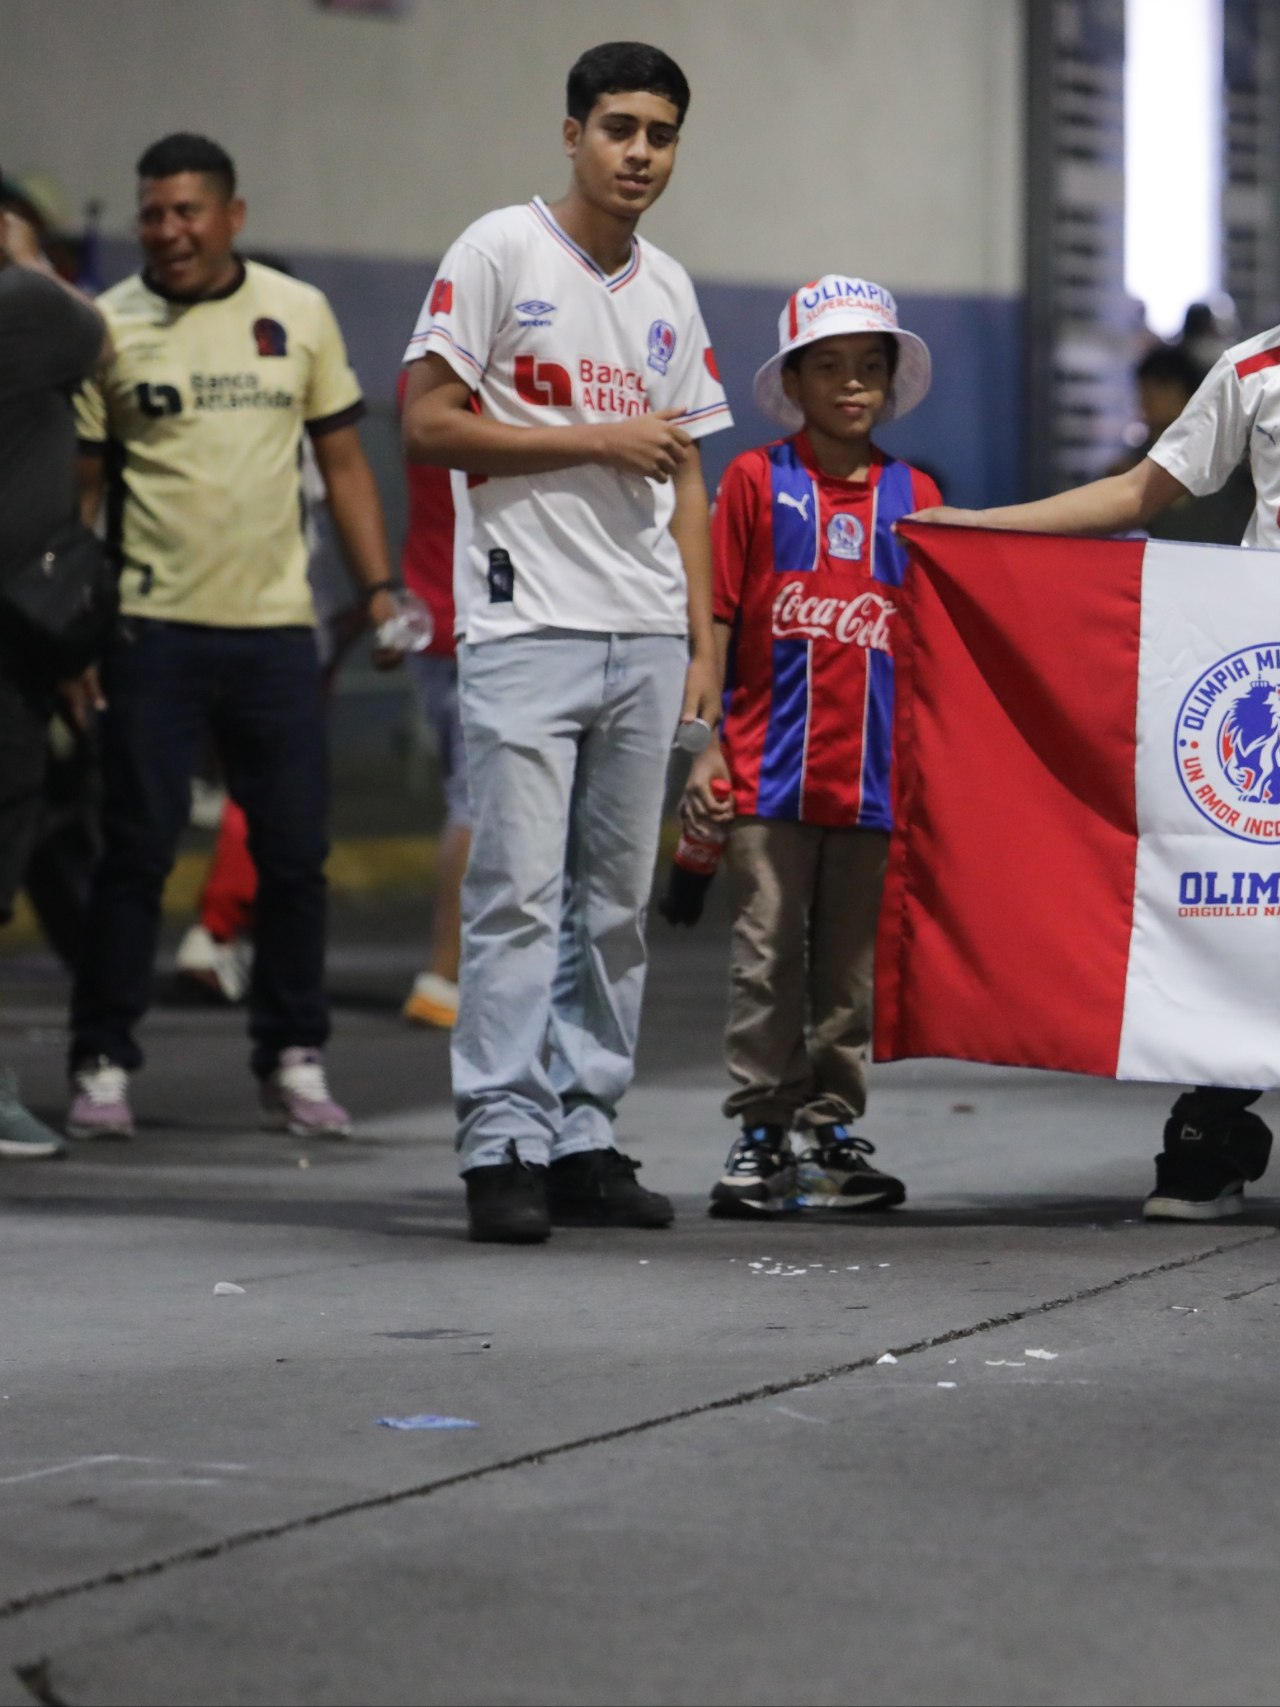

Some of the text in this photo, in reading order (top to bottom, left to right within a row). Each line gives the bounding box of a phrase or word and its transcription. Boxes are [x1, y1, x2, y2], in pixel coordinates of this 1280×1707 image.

[803, 281, 894, 309] OLIMPIA
[190, 373, 259, 389] Banco
[583, 388, 651, 417] Atlán
[1183, 658, 1250, 731] OLIMPIA
[1255, 649, 1280, 671] MI
[1183, 756, 1205, 783] UN
[1195, 783, 1241, 828] AMOR
[1178, 906, 1257, 918] ORGULLO
